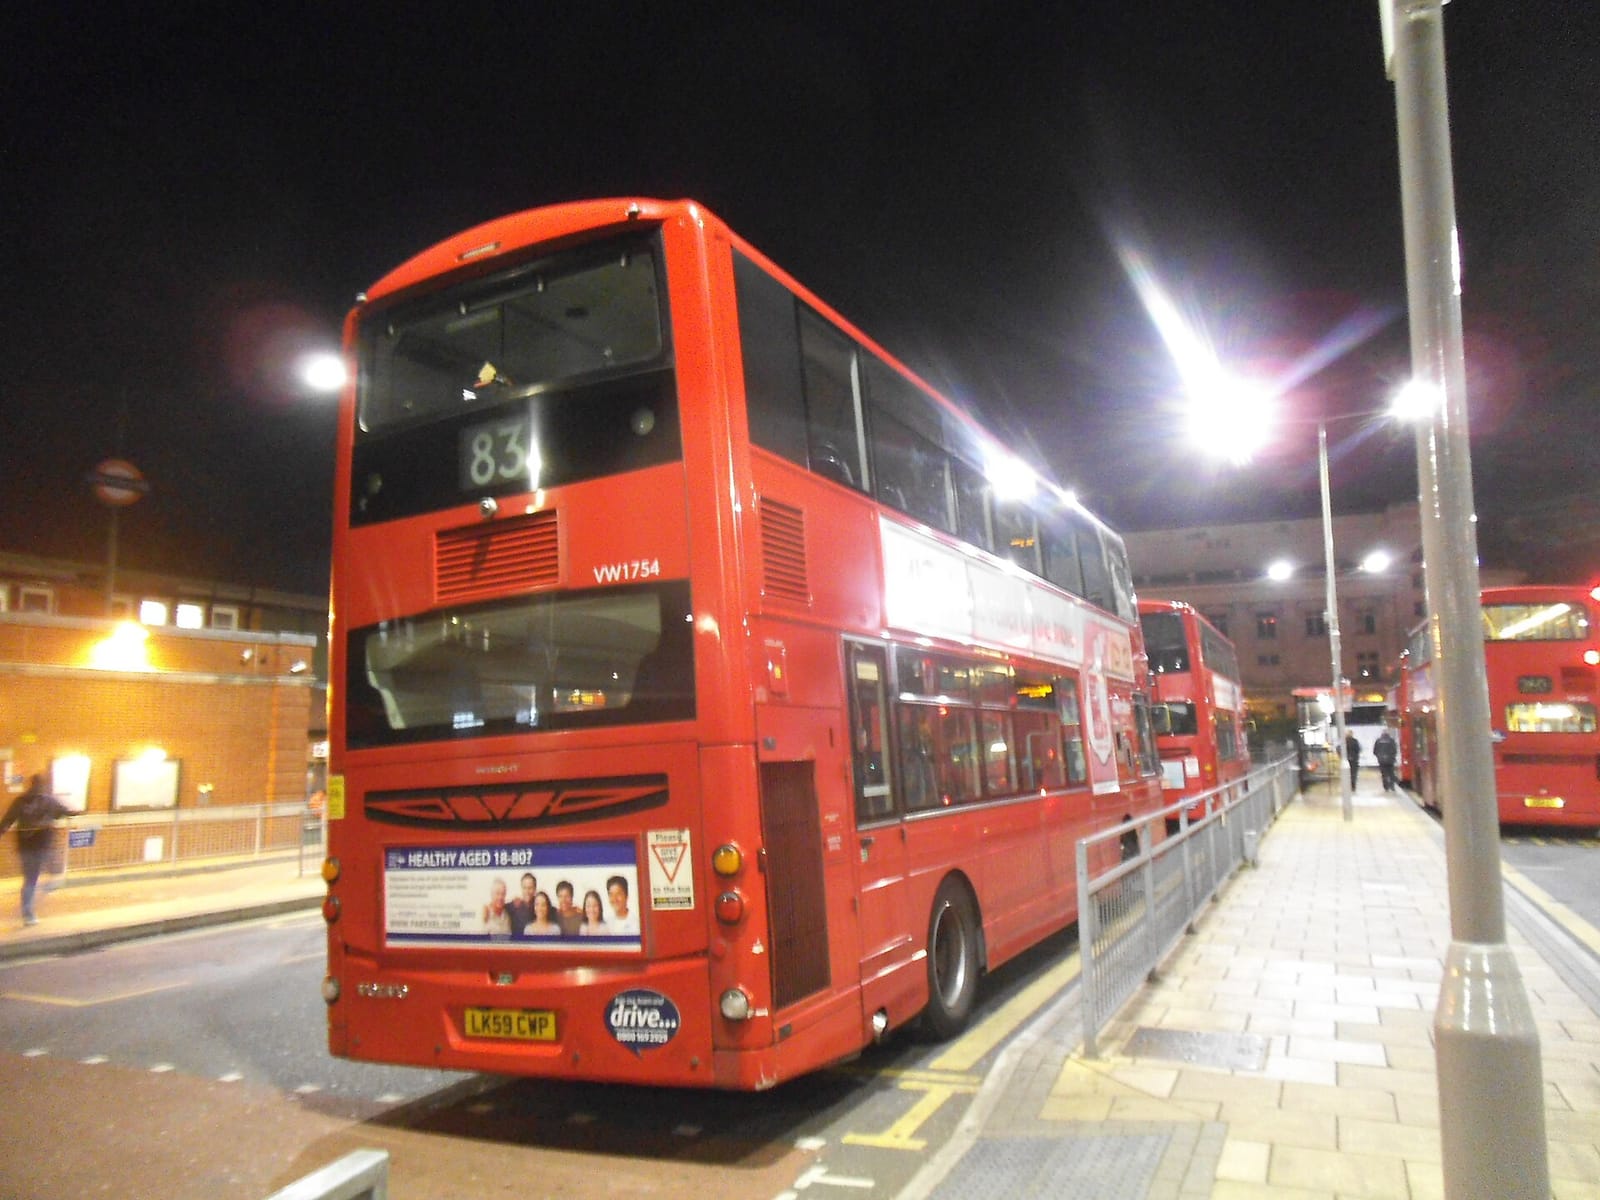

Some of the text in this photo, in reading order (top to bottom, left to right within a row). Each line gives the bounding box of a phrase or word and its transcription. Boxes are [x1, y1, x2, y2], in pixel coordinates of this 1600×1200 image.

[471, 425, 525, 485] 83
[593, 558, 660, 584] VW1754
[408, 850, 457, 867] HEALTHY
[458, 849, 491, 867] AGED
[494, 848, 533, 866] 18-80?
[471, 1014, 549, 1037] LK59 CWP
